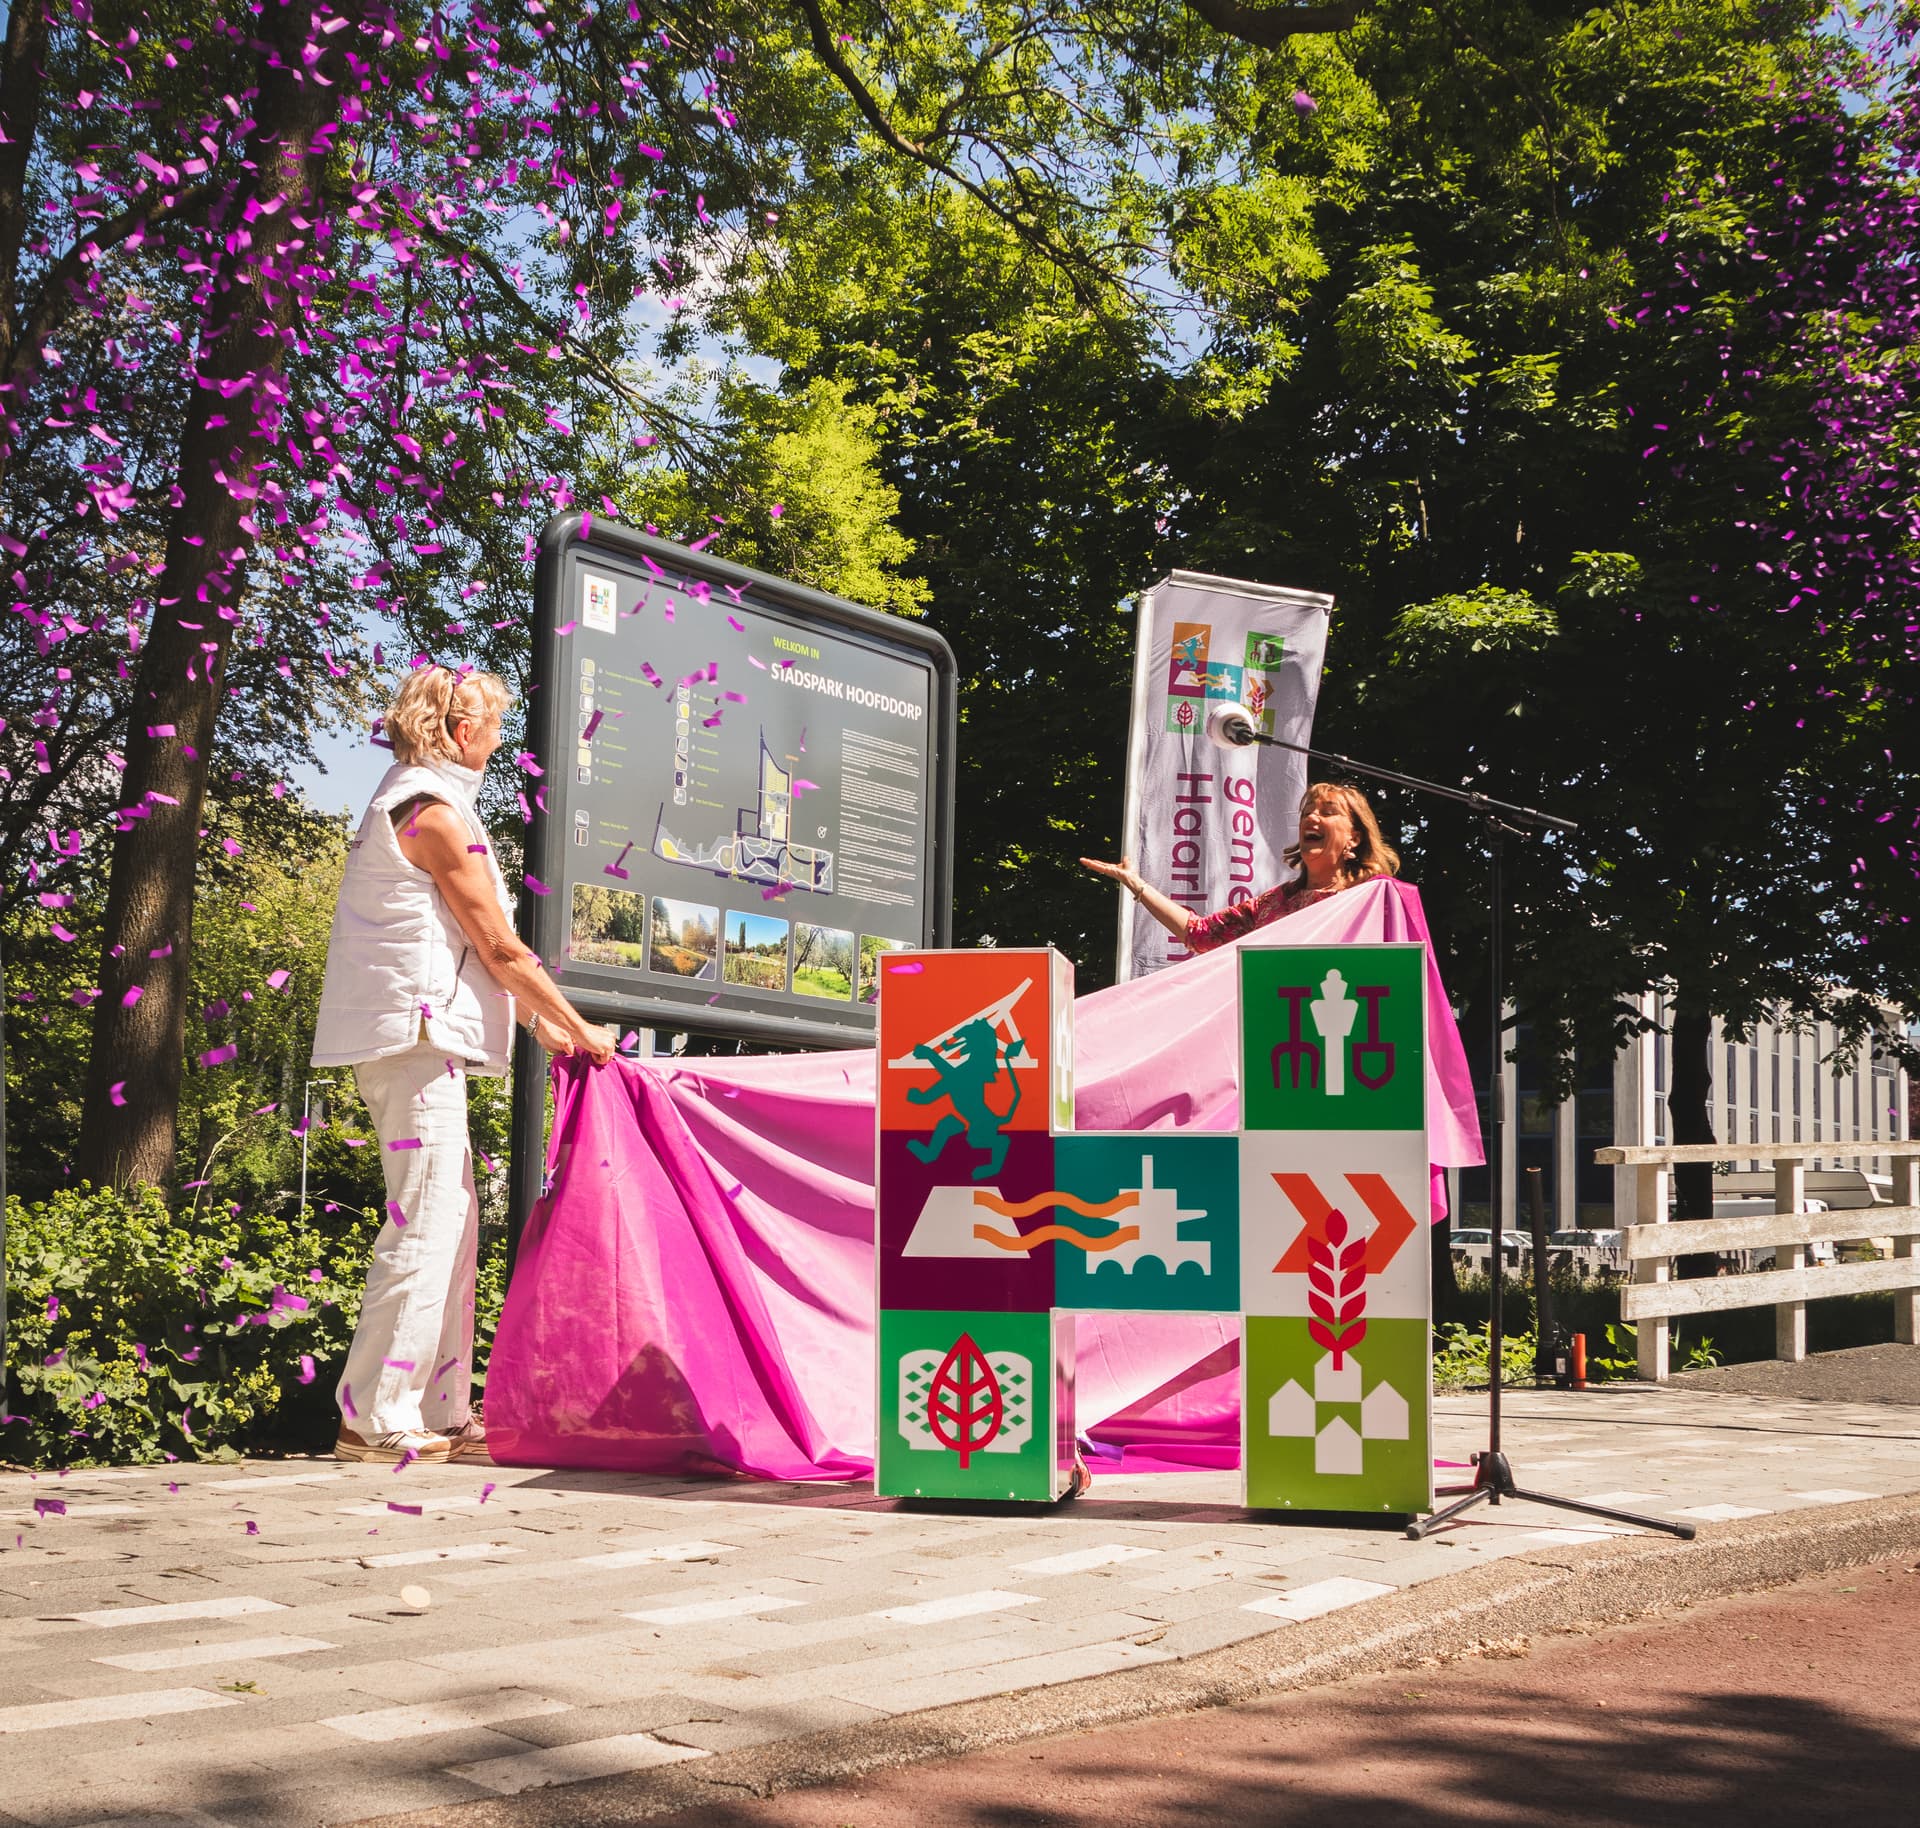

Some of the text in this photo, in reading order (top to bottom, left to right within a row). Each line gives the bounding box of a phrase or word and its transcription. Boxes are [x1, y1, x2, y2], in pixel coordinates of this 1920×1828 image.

[772, 636, 820, 660] WELKOM IN
[771, 662, 922, 721] STADSPARK HOOFDDORP
